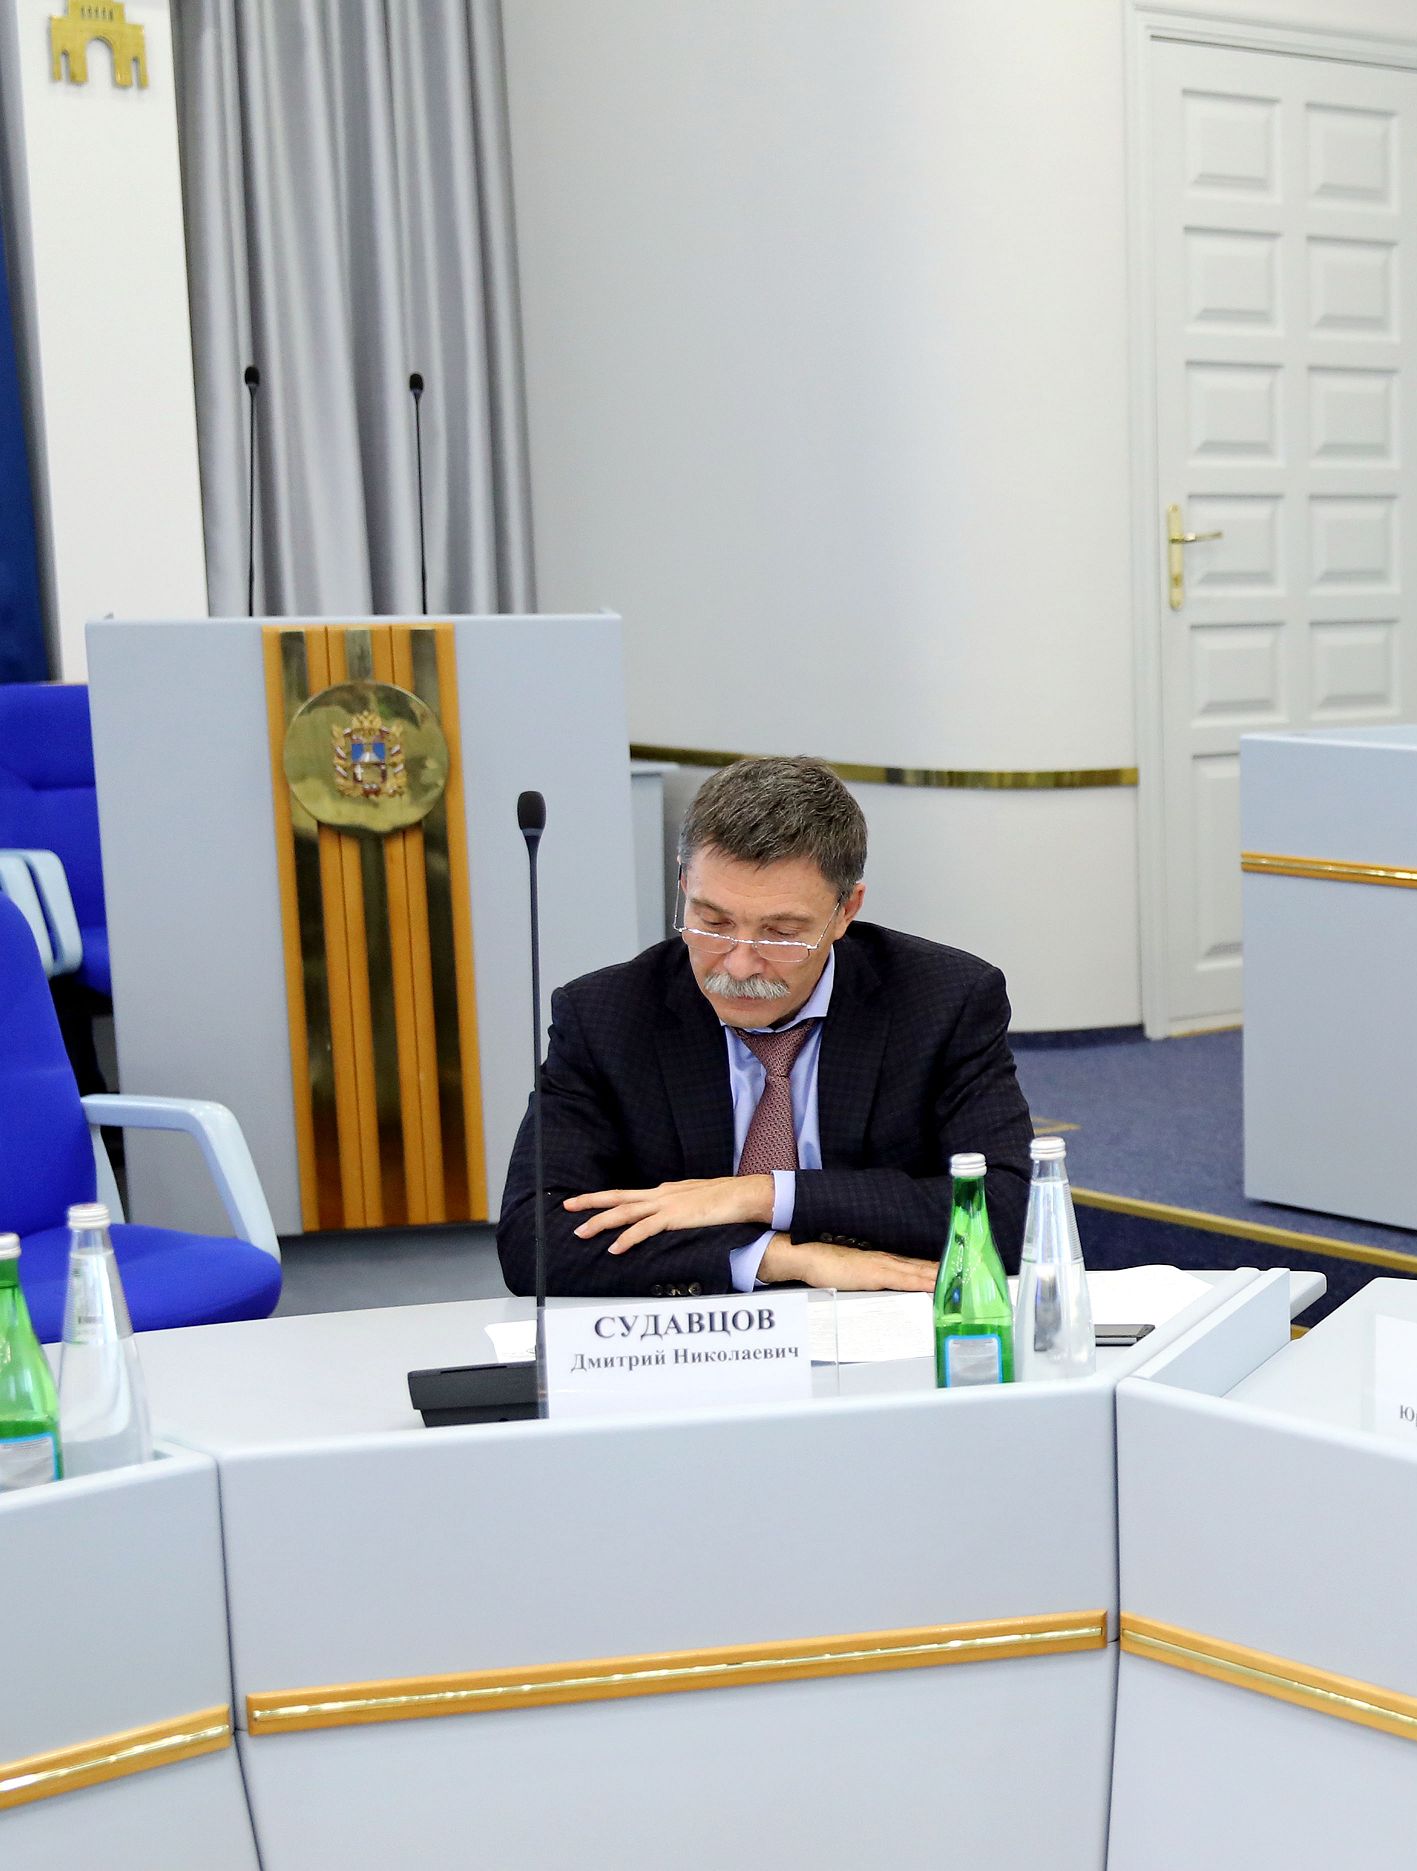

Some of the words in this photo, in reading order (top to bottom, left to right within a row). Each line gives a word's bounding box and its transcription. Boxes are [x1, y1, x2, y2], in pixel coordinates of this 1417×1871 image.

[593, 1308, 776, 1341] СУДАВЦОВ
[571, 1349, 667, 1373] Дмитрий
[673, 1346, 799, 1365] Николаевич
